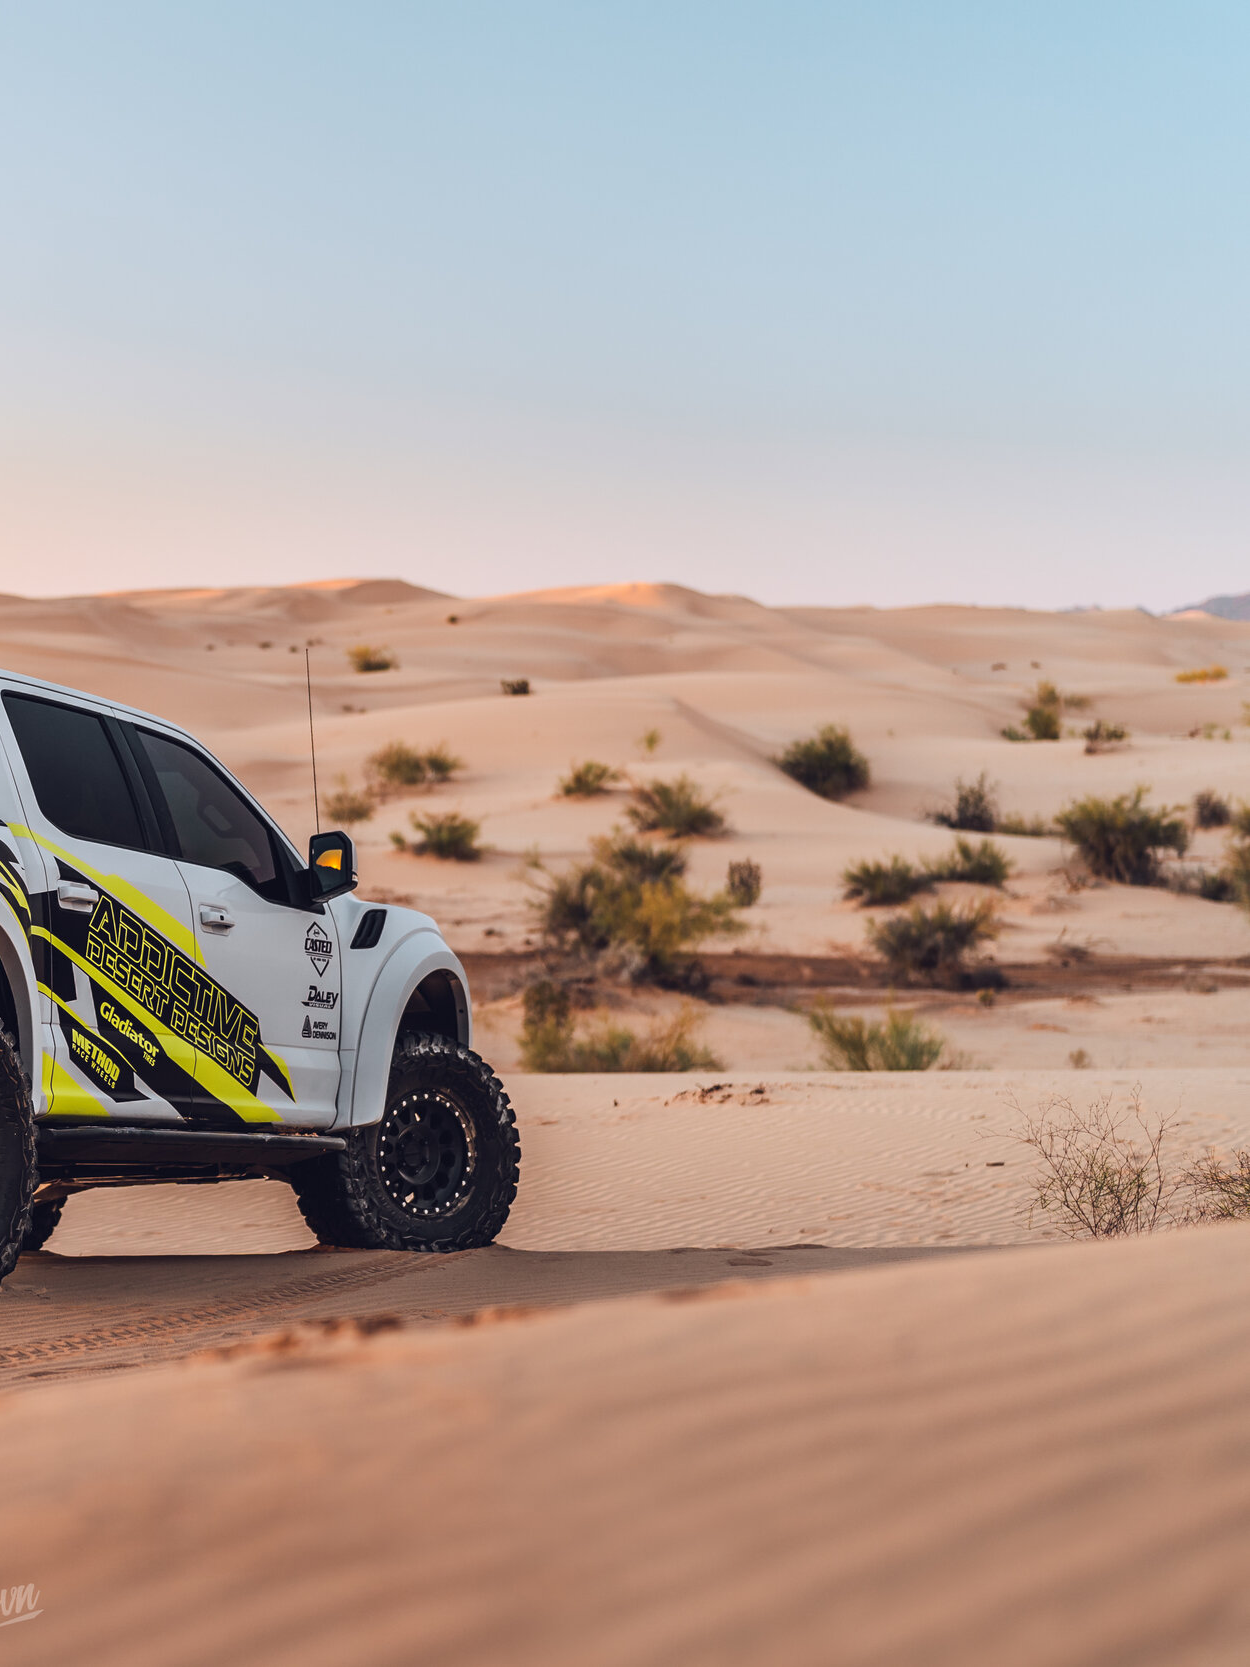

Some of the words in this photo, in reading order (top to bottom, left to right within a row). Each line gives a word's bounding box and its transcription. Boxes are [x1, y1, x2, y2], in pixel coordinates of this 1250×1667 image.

[304, 938, 332, 953] CASTED
[88, 895, 259, 1059] ADDICTIVE
[85, 931, 170, 1017] DESERT
[170, 1001, 255, 1086] DESIGNS
[307, 985, 339, 1009] DALEY
[100, 1001, 159, 1057] Gladiator
[313, 1021, 328, 1030] AVERY
[313, 1030, 337, 1040] DENNISON
[72, 1028, 120, 1082] METHOD
[72, 1043, 89, 1062] RACE
[91, 1062, 116, 1089] WHEELS
[142, 1051, 156, 1067] TIRES
